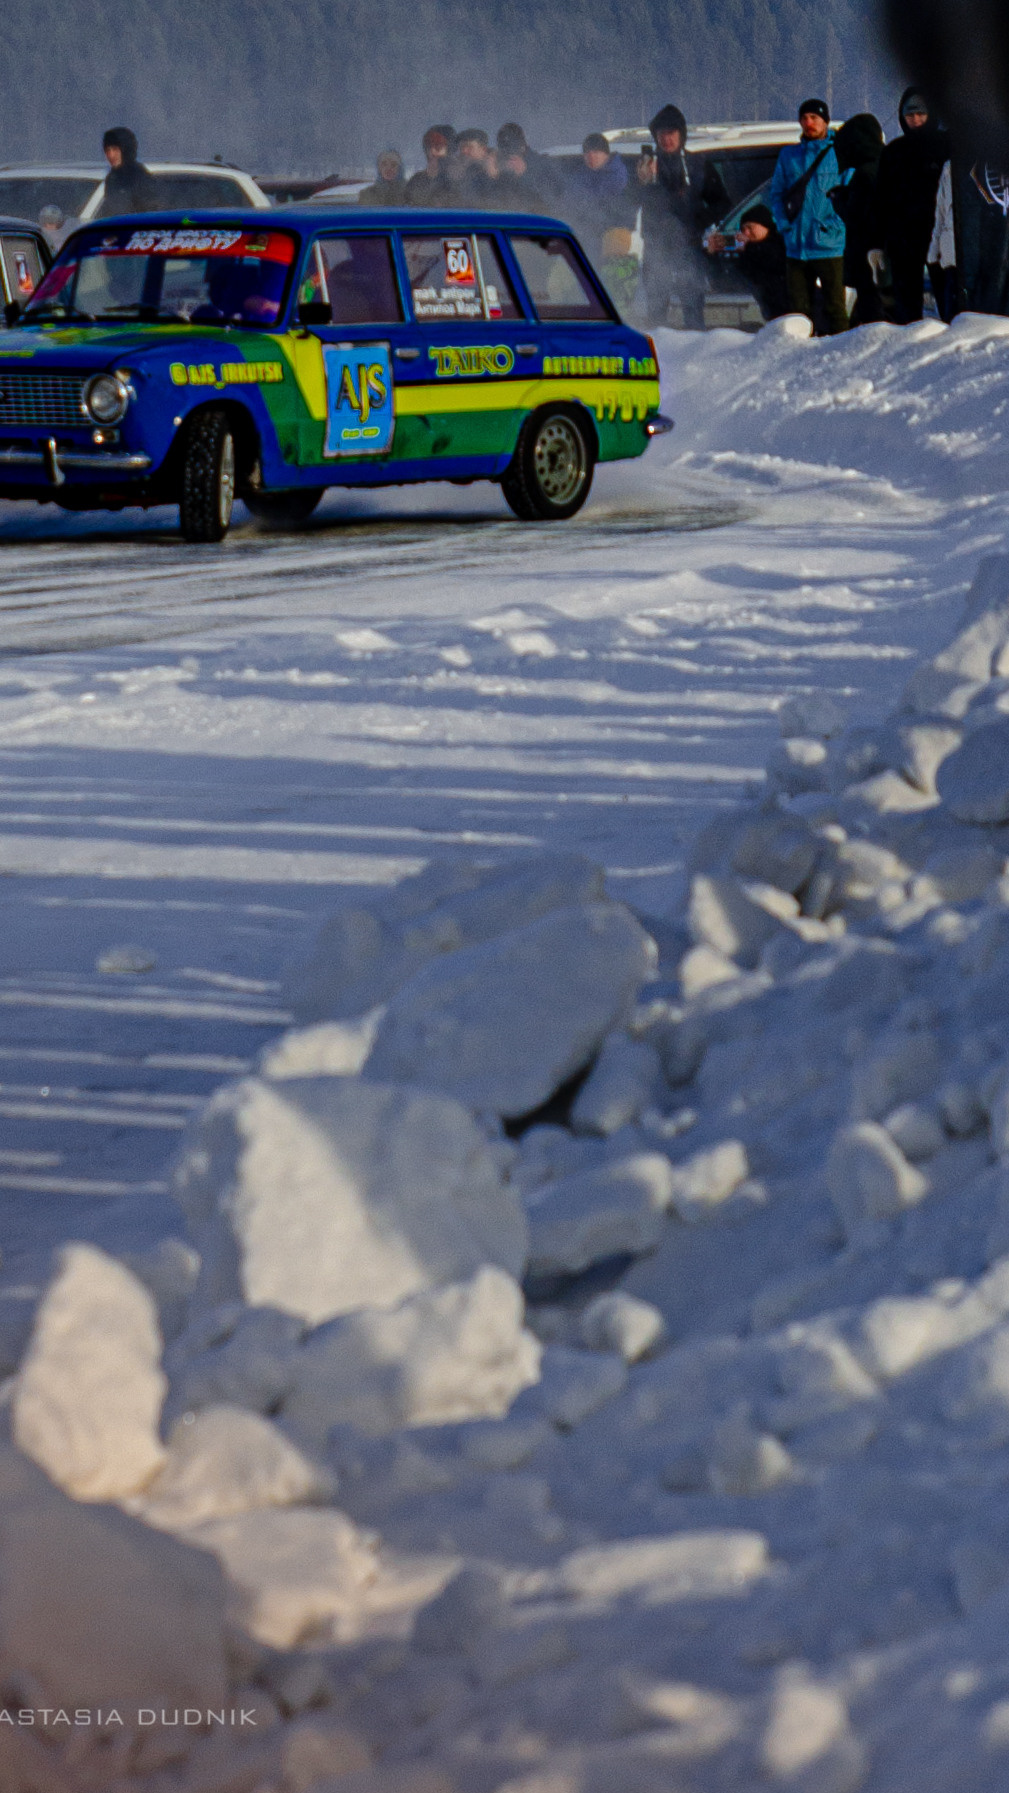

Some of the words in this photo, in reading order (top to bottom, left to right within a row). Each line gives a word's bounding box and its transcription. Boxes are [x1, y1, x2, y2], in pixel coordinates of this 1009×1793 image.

[447, 249, 468, 273] 60
[429, 344, 514, 376] TAIKO
[337, 363, 386, 423] AJS
